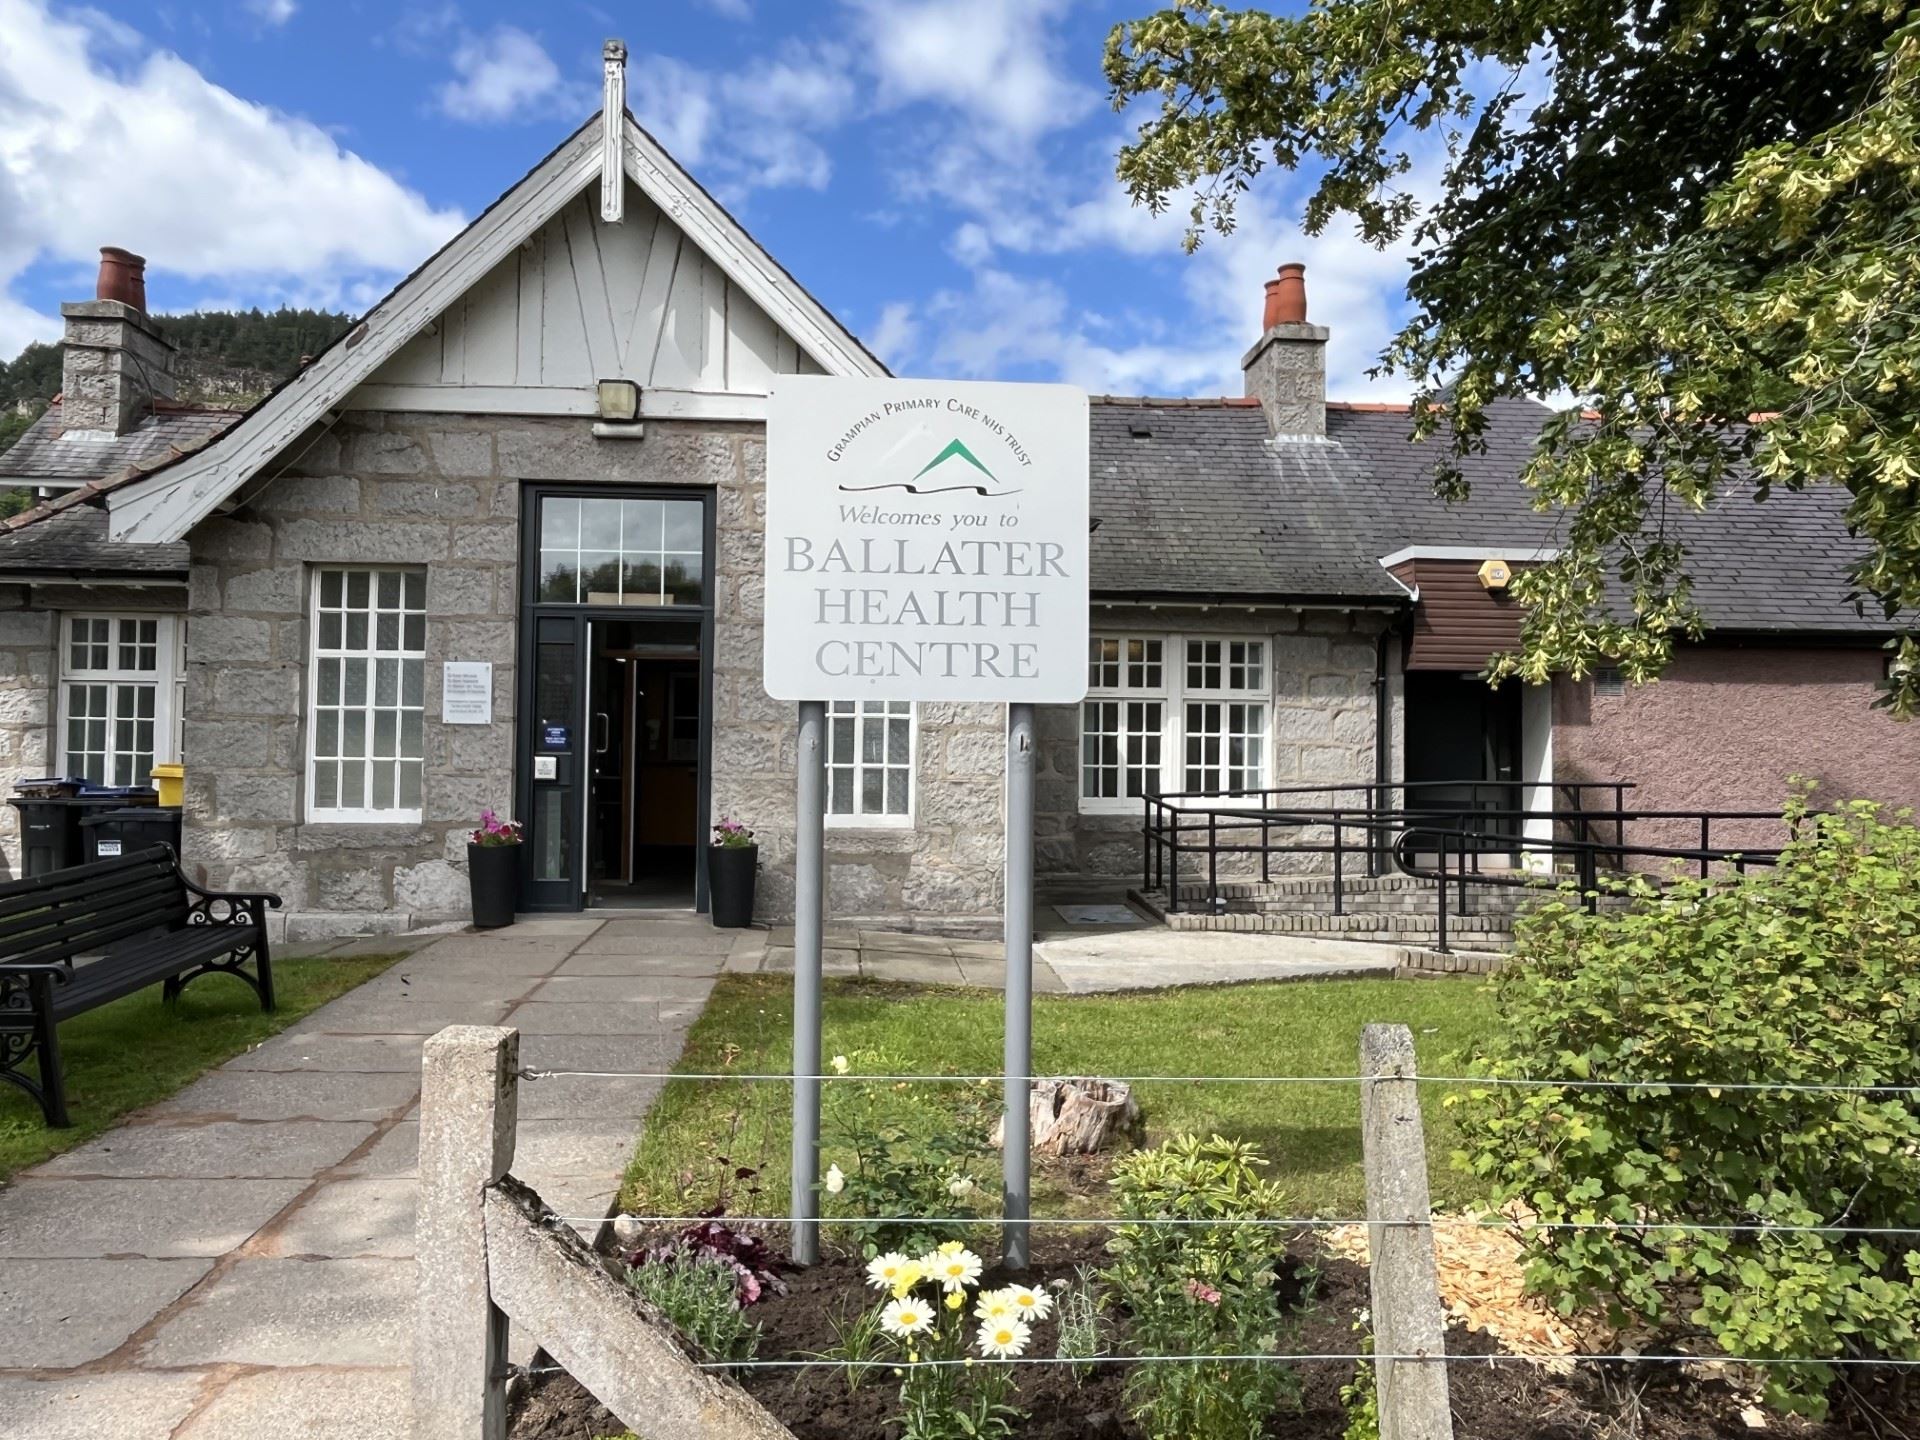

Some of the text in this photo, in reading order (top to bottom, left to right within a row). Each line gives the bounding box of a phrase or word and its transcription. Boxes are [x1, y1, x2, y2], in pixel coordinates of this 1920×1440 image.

[827, 398, 1032, 467] GRAMPIAN PRIMARY CARE NHS TRUST
[839, 504, 1019, 531] Welcomes you to
[783, 536, 1071, 578] BALLATER
[813, 588, 1041, 628] HEALTH
[815, 640, 1040, 678] CENTRE
